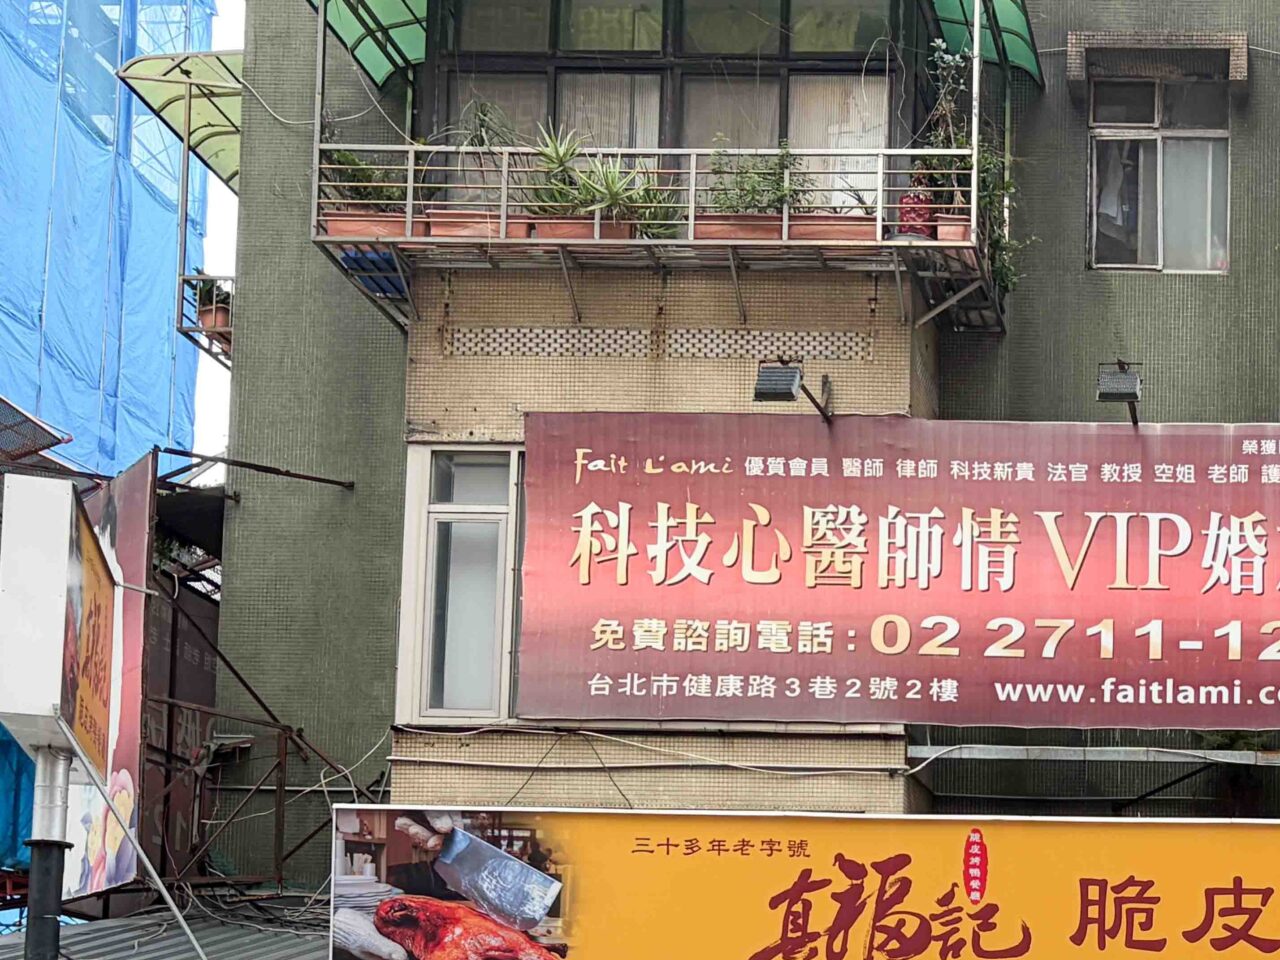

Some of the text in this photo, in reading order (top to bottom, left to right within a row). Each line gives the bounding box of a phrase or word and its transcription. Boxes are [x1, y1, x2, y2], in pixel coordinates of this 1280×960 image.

[574, 448, 627, 484] Fait
[745, 456, 829, 477] 優質會員
[842, 458, 884, 478] 醫師
[896, 459, 938, 479] 律師
[950, 461, 1035, 482] 科技新貴
[1047, 462, 1088, 483] 法官
[1100, 463, 1142, 484] 教授
[1154, 464, 1196, 484] 空姐
[1208, 464, 1249, 484] 老師
[870, 614, 962, 657] 02
[587, 673, 960, 703] 台北市健康路3巷2號2樓
[631, 837, 811, 858] 三十多年老字號
